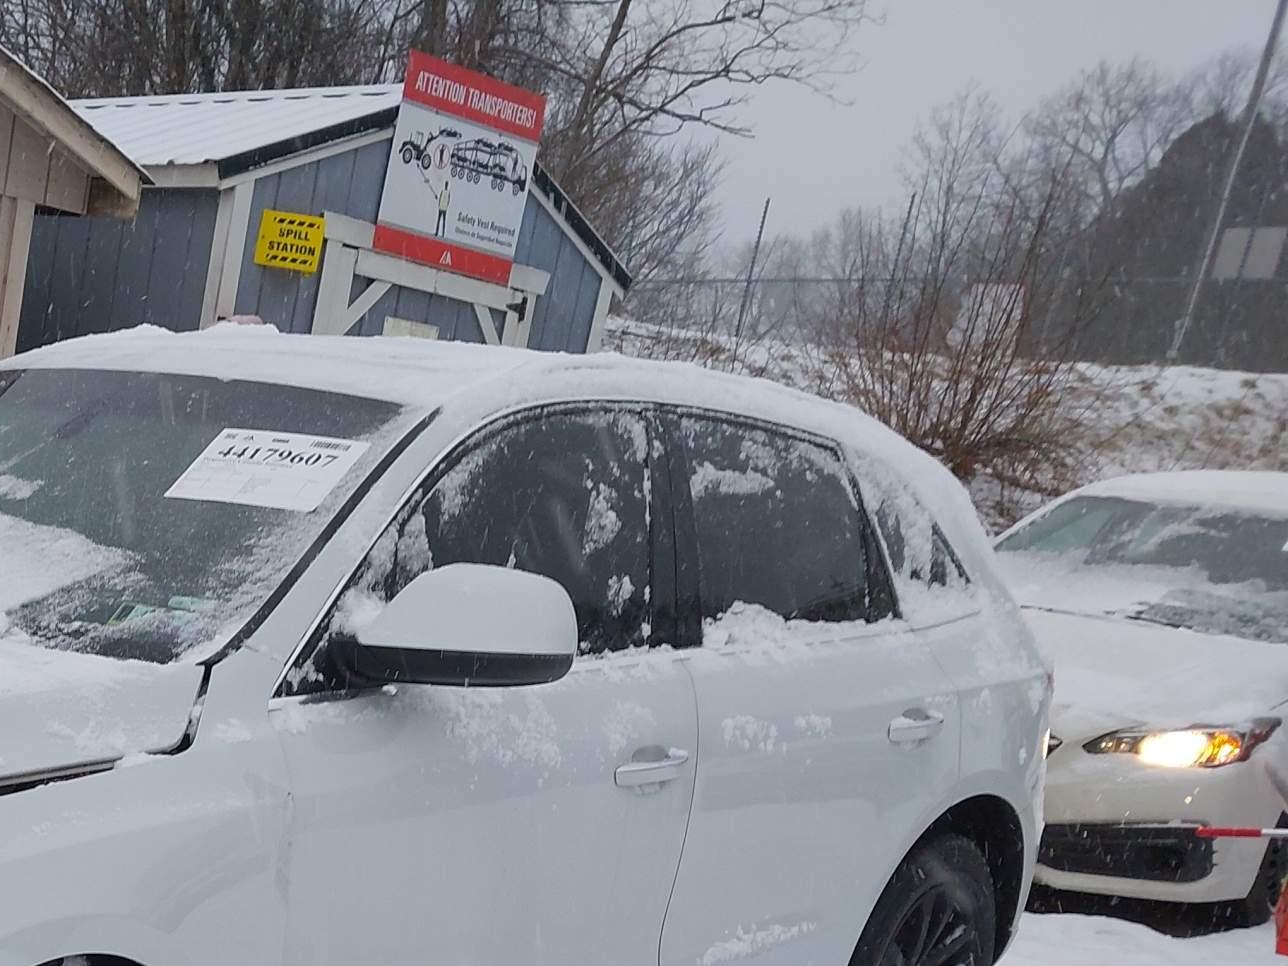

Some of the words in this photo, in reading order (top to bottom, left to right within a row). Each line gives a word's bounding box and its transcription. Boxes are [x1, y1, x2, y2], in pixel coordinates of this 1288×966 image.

[416, 71, 467, 105] ATTENTION
[467, 88, 536, 128] TRANSPORTERS!
[457, 211, 476, 227] Safety
[477, 216, 489, 229] Vest
[278, 228, 310, 241] SPILL
[268, 241, 315, 256] STATION
[218, 444, 339, 468] 44179607
